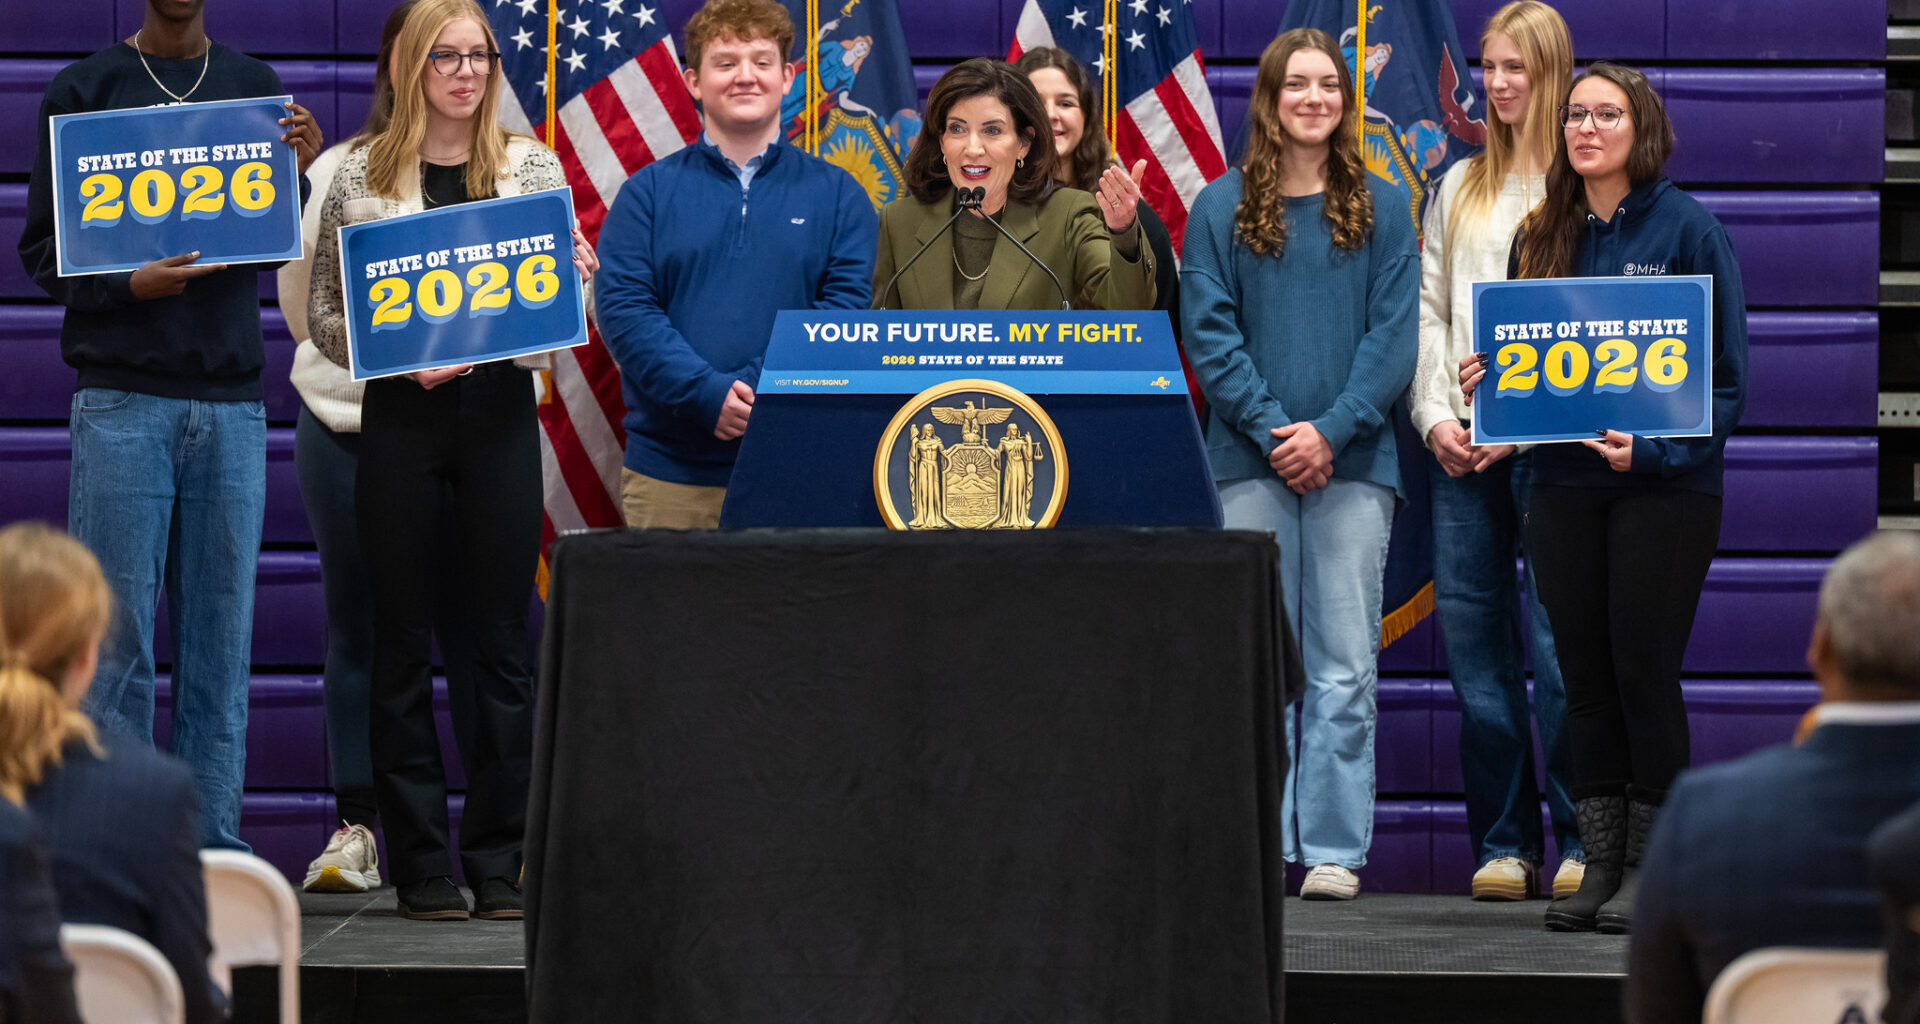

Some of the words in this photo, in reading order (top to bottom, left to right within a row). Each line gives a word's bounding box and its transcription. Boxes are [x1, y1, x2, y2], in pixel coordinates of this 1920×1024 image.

[77, 151, 137, 173] STATE
[141, 149, 166, 167] OF
[168, 146, 209, 165] THE
[211, 141, 273, 162] STATE
[79, 161, 276, 226] 2026
[365, 253, 423, 279] STATE
[425, 248, 451, 268] OF
[453, 243, 494, 264] THE
[495, 233, 556, 258] STATE
[367, 254, 561, 330] 2026
[803, 323, 879, 343] YOUR
[887, 323, 1001, 343] FUTURE.
[1008, 323, 1051, 343] MY
[1057, 323, 1142, 343] FIGHT.
[1494, 322, 1553, 341] STATE
[1556, 321, 1581, 339] OF
[1584, 319, 1625, 337] THE
[1627, 318, 1688, 337] STATE
[881, 355, 916, 365] 2026
[918, 355, 963, 365] STATE
[965, 355, 985, 365] OF
[987, 355, 1017, 365] THE
[1019, 355, 1064, 365] STATE
[1495, 338, 1690, 394] 2026
